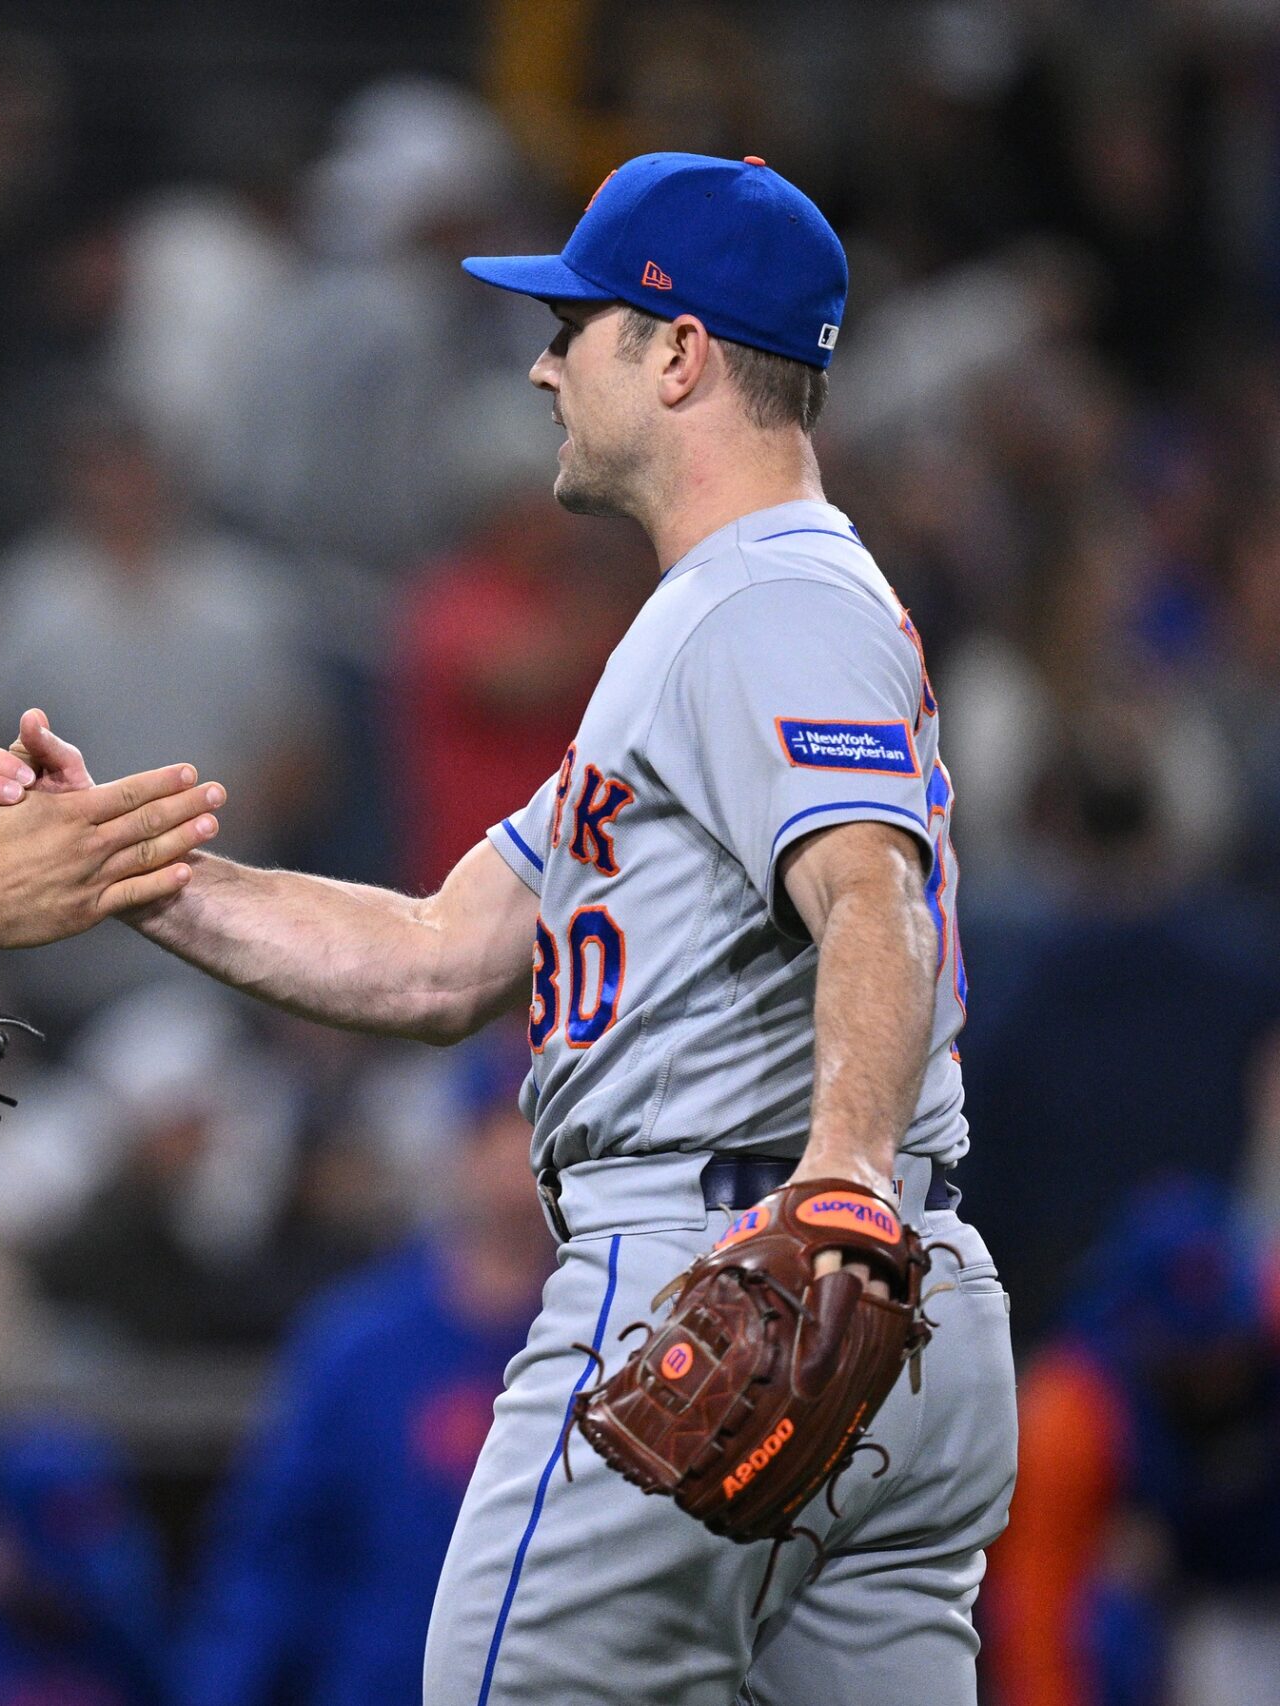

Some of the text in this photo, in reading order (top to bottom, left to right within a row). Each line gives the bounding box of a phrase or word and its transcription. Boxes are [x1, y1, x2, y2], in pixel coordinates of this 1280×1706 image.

[810, 743, 905, 760] Presbyterian
[527, 905, 626, 1054] 30
[813, 1200, 894, 1237] Wilson
[722, 1417, 795, 1501] A2000
